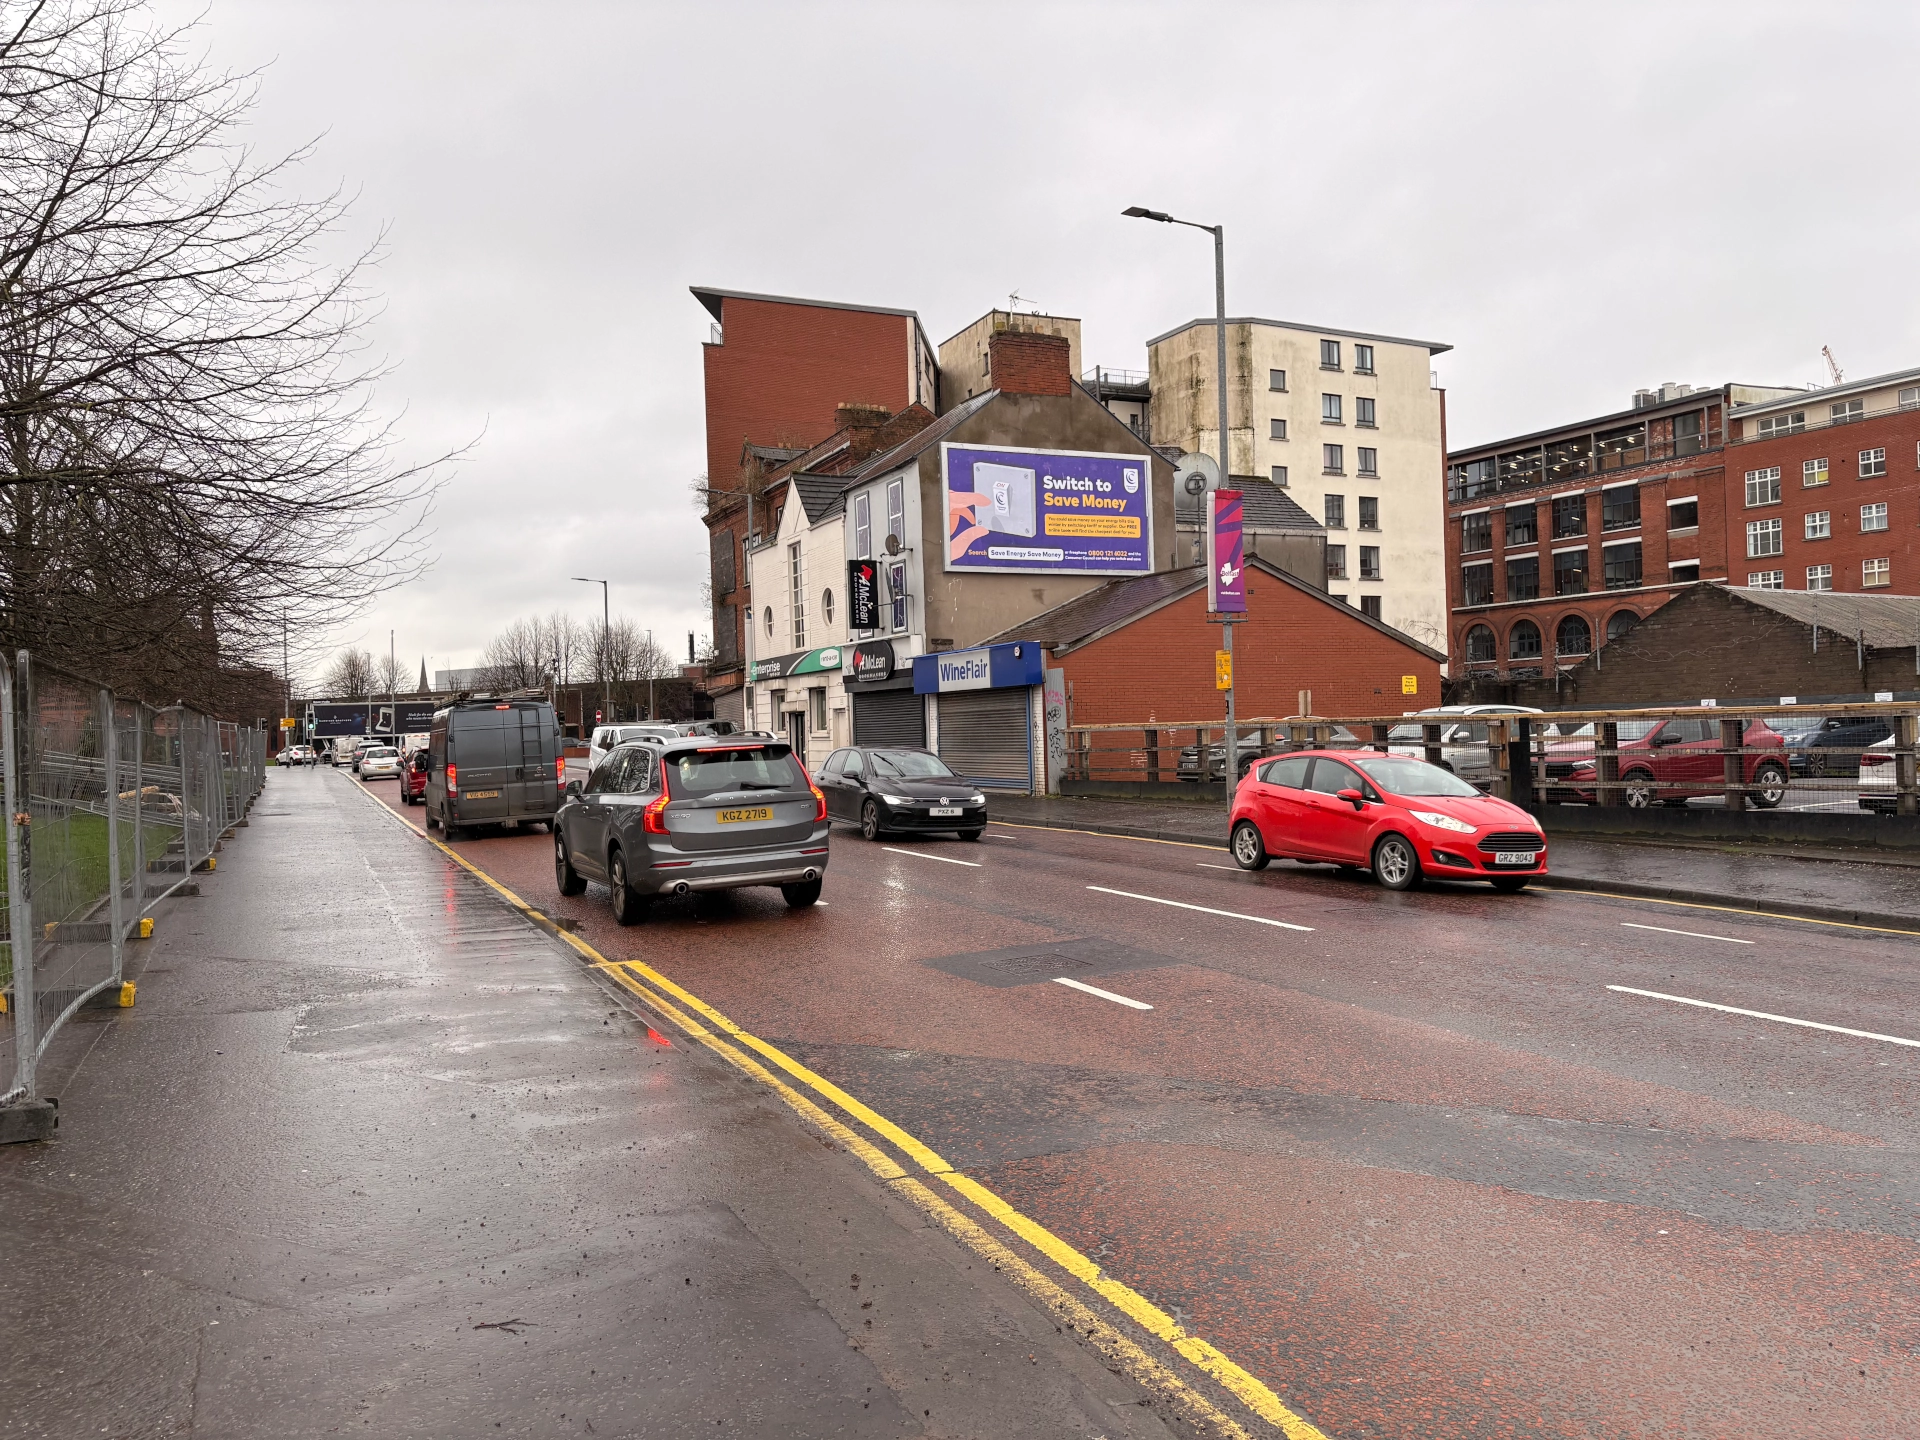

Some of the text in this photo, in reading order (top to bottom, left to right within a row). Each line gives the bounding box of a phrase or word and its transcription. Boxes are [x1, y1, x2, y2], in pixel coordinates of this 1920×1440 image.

[1043, 476, 1112, 491] Switch to
[1044, 492, 1127, 512] Save Money
[1042, 551, 1061, 559] Money
[858, 573, 870, 623] A.McLean
[751, 661, 780, 675] enterprise
[859, 654, 885, 672] A.McLean
[940, 659, 987, 681] WineFlair
[723, 809, 767, 821] KGZ 2719
[1499, 854, 1532, 862] GRZ 9043
